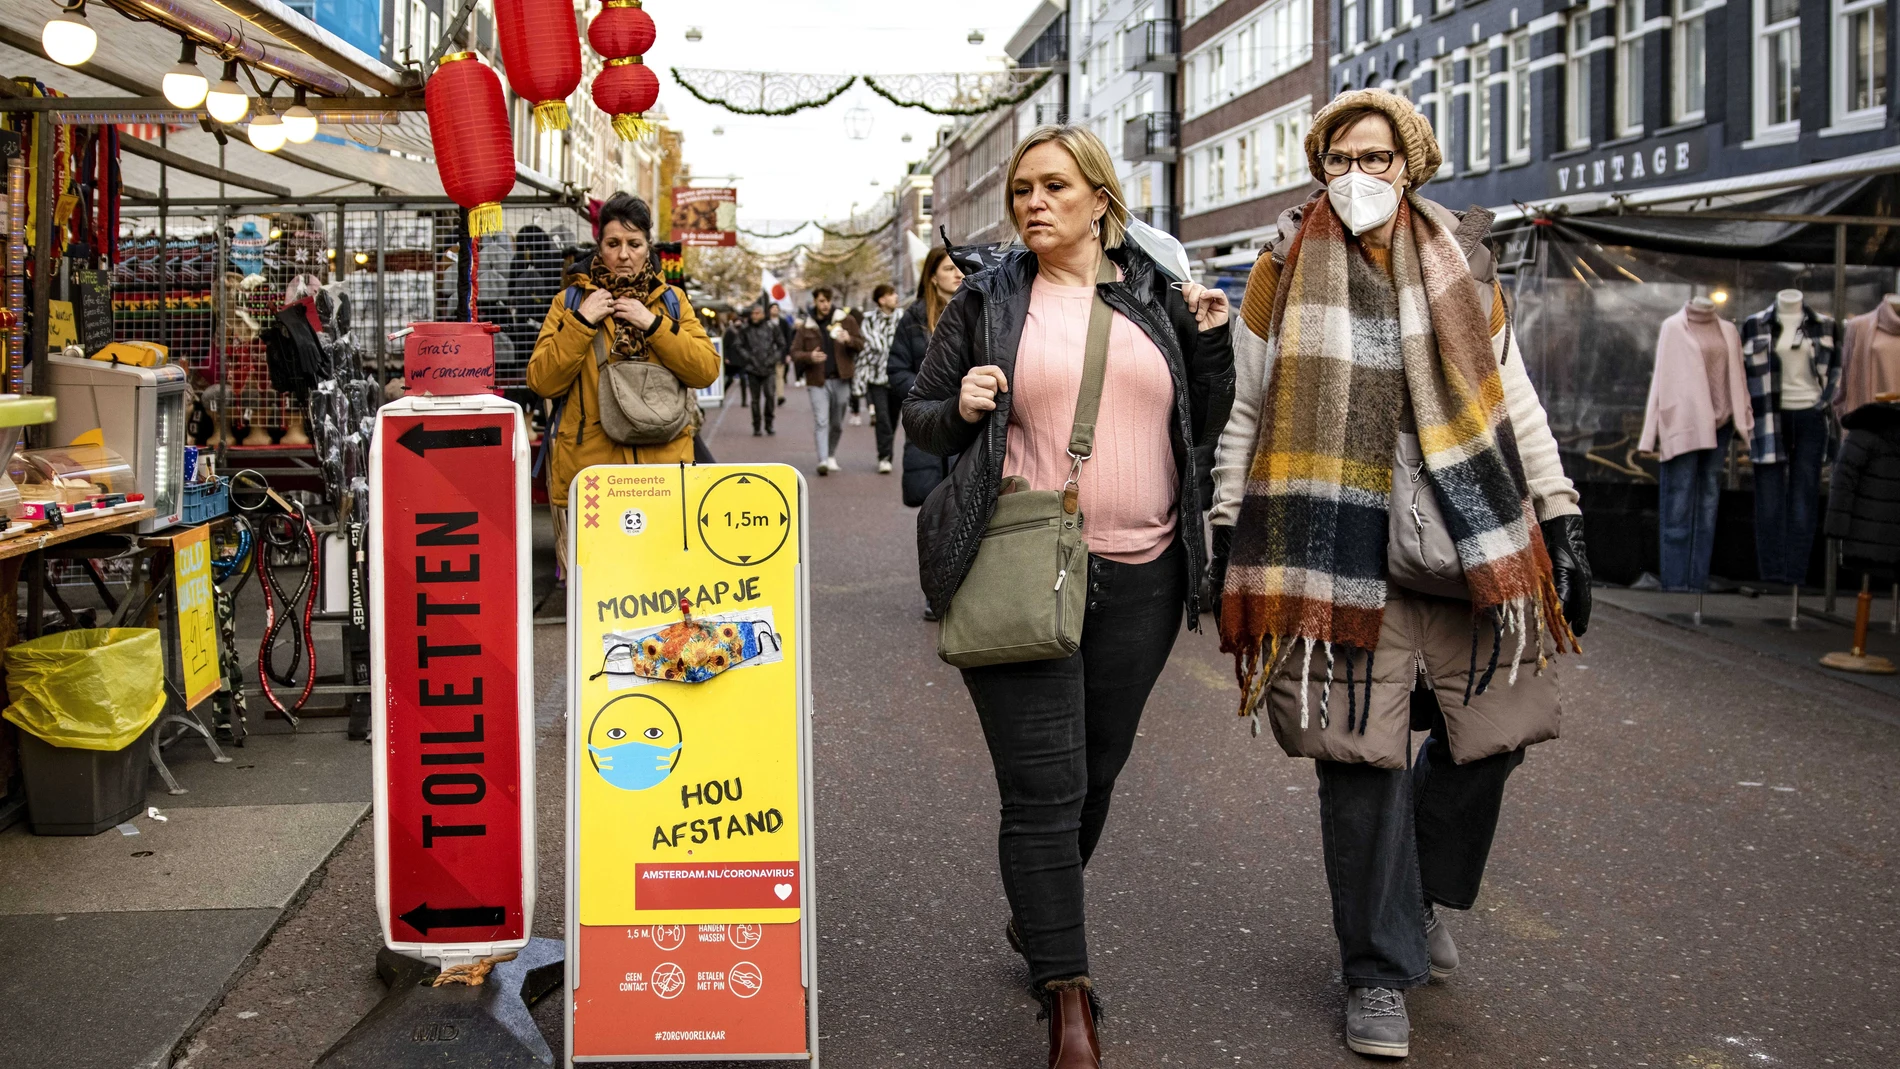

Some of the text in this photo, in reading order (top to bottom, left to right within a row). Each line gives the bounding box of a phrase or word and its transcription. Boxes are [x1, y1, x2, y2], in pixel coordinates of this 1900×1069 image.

[1557, 141, 1691, 192] VINTAGE
[417, 339, 461, 356] Gratis
[607, 475, 665, 485] Gemeente
[607, 487, 671, 497] Amsterdam
[724, 511, 769, 529] 1,5m
[179, 541, 205, 577] COLD
[178, 577, 211, 613] WATER
[598, 576, 761, 622] MONDKAPJE
[415, 511, 487, 849] TOILETTEN
[681, 777, 743, 809] HOU
[652, 808, 784, 851] AFSTAND
[642, 868, 795, 879] AMSTERDAM.NL/CORONAVIRUS
[698, 924, 725, 933] HANDEN
[627, 929, 639, 939] 1,5
[698, 933, 725, 942] WASSEN
[625, 972, 643, 981] GEEN
[697, 971, 725, 981] BETALEN
[619, 982, 648, 992] CONTACT
[697, 981, 725, 991] MET PIN
[655, 1031, 726, 1041] #ZORGVOORELKAAR
